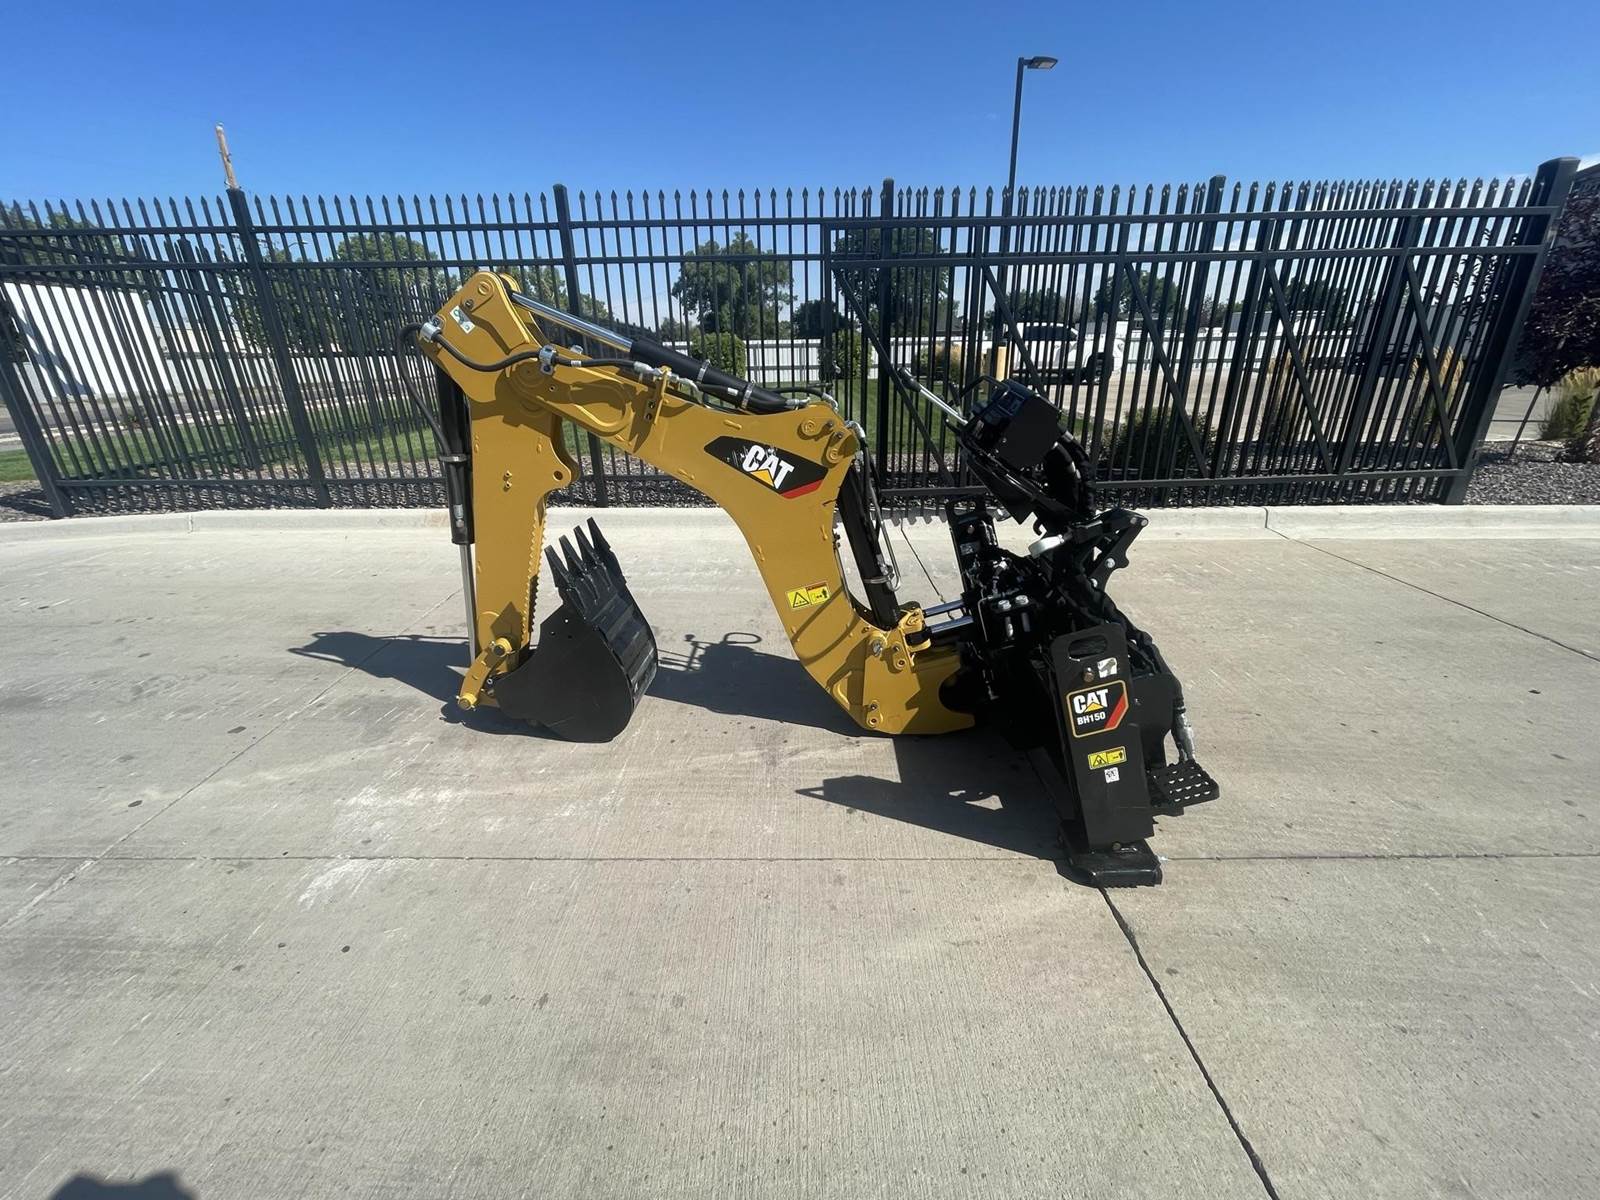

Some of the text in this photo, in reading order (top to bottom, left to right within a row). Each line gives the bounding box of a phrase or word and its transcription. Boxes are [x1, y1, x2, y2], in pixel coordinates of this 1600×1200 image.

[742, 445, 794, 489] CAT
[1073, 688, 1108, 714] CAT
[1077, 712, 1106, 725] BH150
